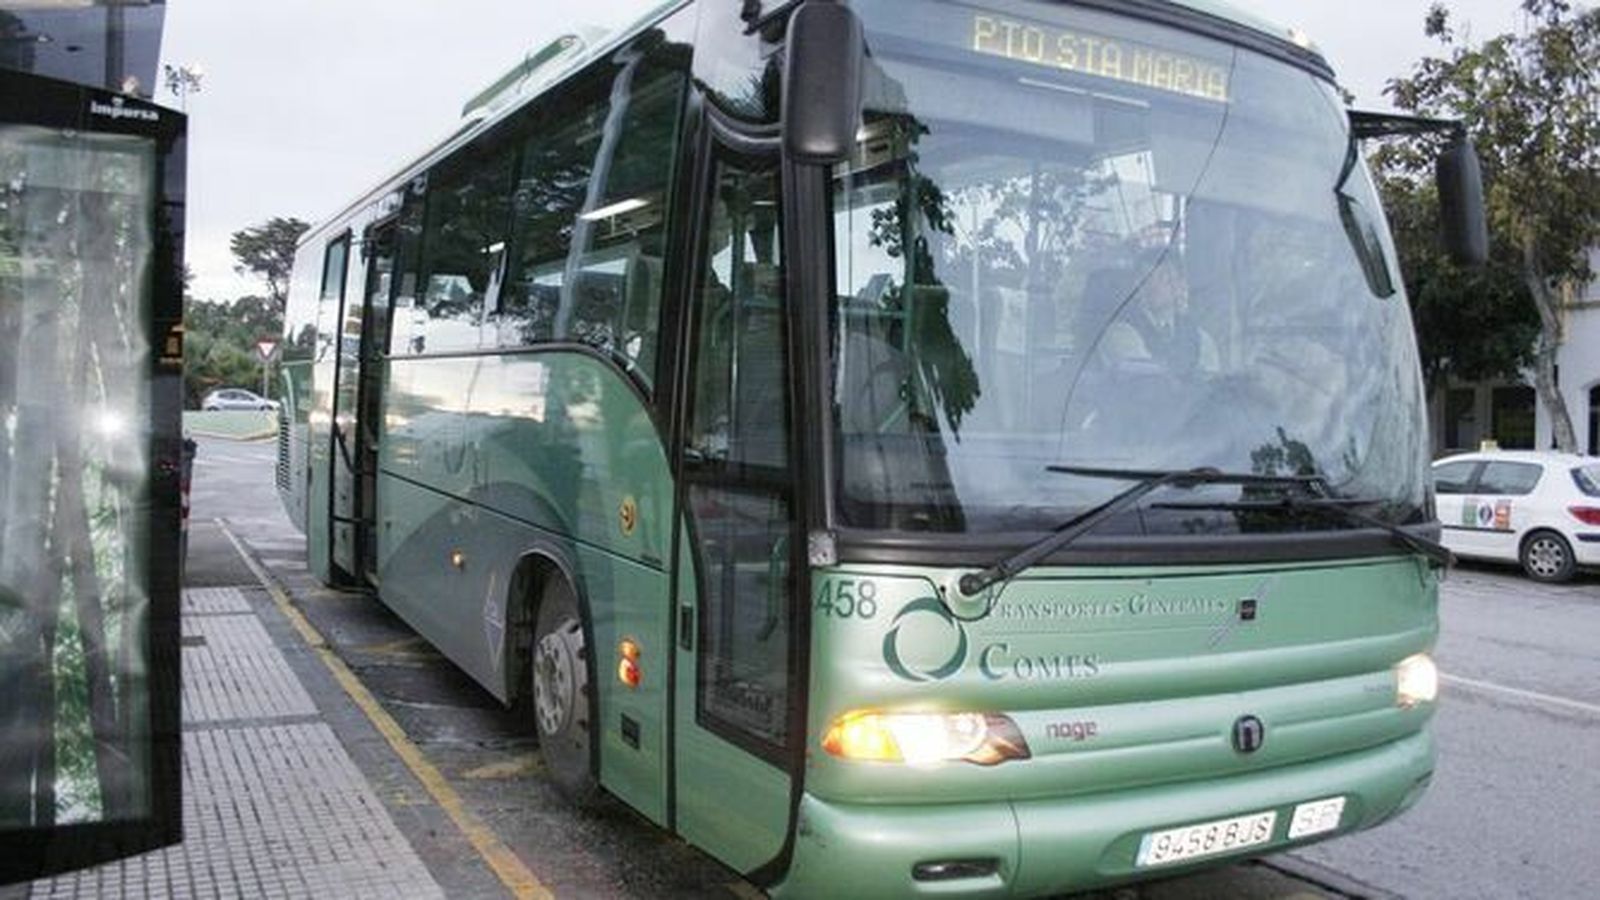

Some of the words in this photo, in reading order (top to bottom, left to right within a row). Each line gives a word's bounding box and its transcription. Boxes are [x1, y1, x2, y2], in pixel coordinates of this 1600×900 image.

[974, 16, 1045, 62] PTO
[1057, 33, 1121, 79] STA
[1132, 50, 1226, 101] MARIA
[816, 580, 877, 619] 458
[979, 642, 1099, 680] COMES
[1155, 825, 1219, 860] 9458
